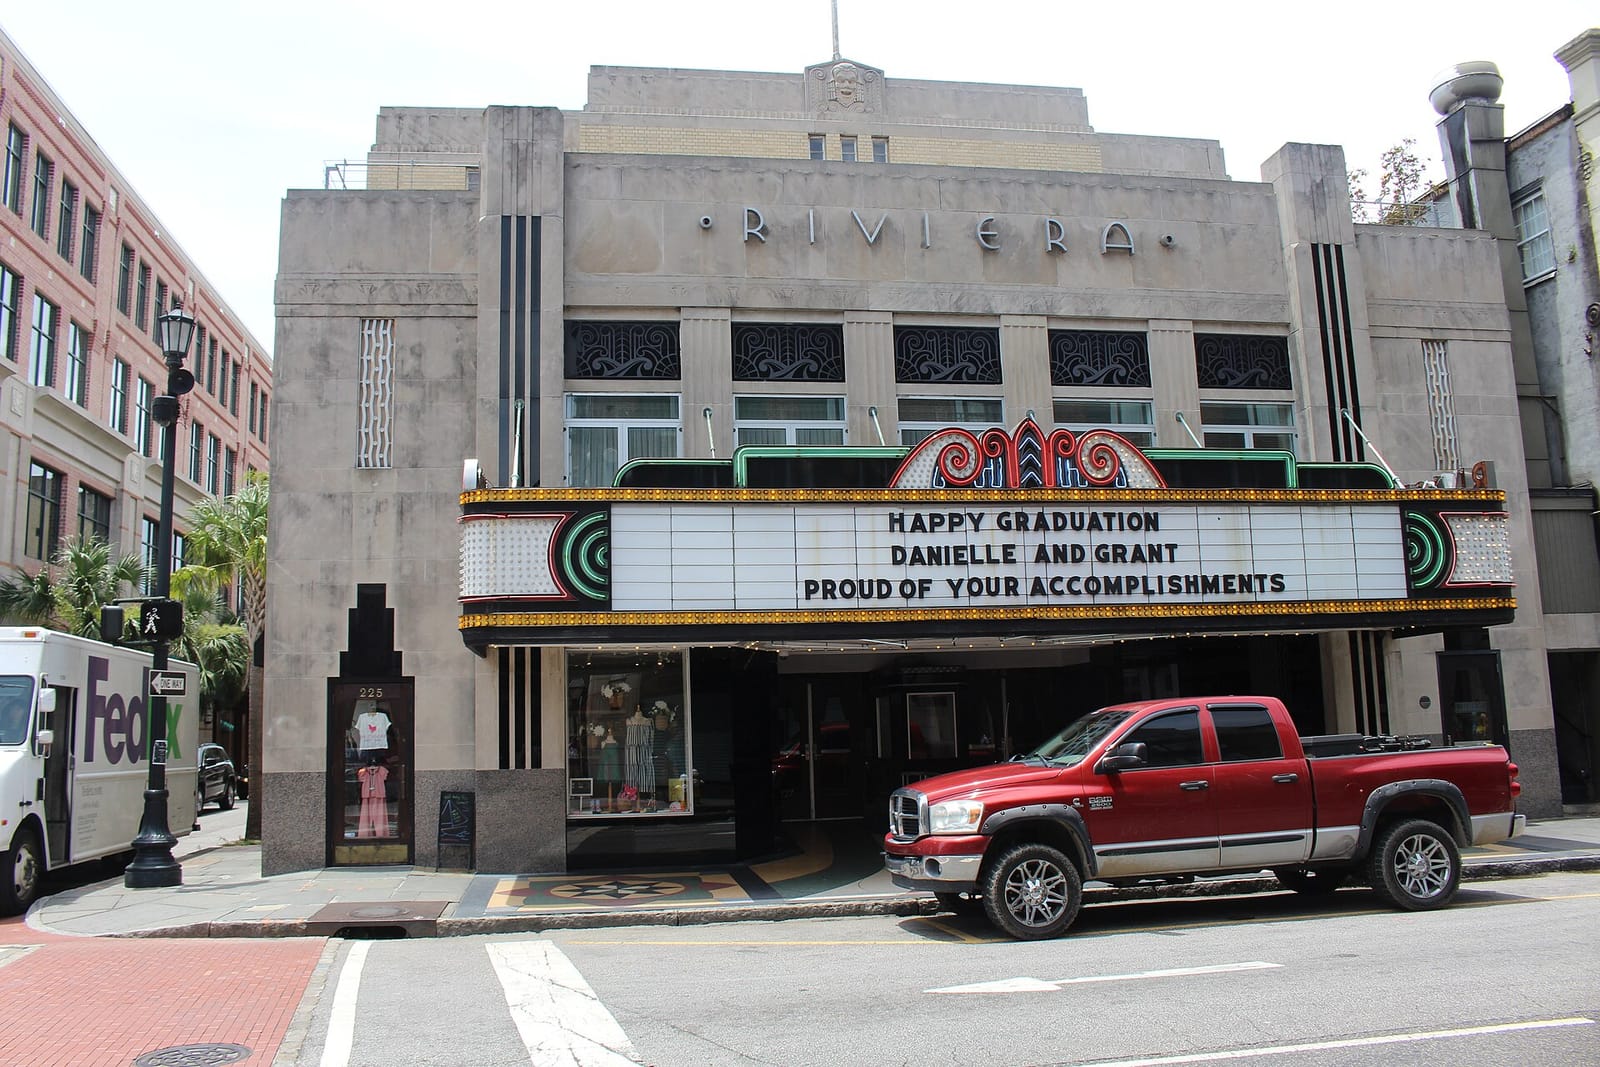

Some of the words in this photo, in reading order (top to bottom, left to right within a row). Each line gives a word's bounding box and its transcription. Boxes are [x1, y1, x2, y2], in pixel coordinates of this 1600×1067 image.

[743, 207, 1135, 256] RIVIERA
[889, 512, 985, 533] HAPPY
[996, 511, 1160, 532] GRADUATION
[891, 544, 1017, 566] DANIELLE
[1034, 543, 1086, 564] AND
[1094, 543, 1178, 564] GRANT
[804, 578, 892, 600] PROUD
[899, 578, 933, 599] OF
[946, 576, 1019, 599] YOUR
[1029, 574, 1286, 597] ACCOMPLISHMENTS
[160, 678, 171, 689] ONE
[172, 678, 183, 689] WAY
[359, 687, 383, 698] 225
[84, 656, 182, 764] Fedx
